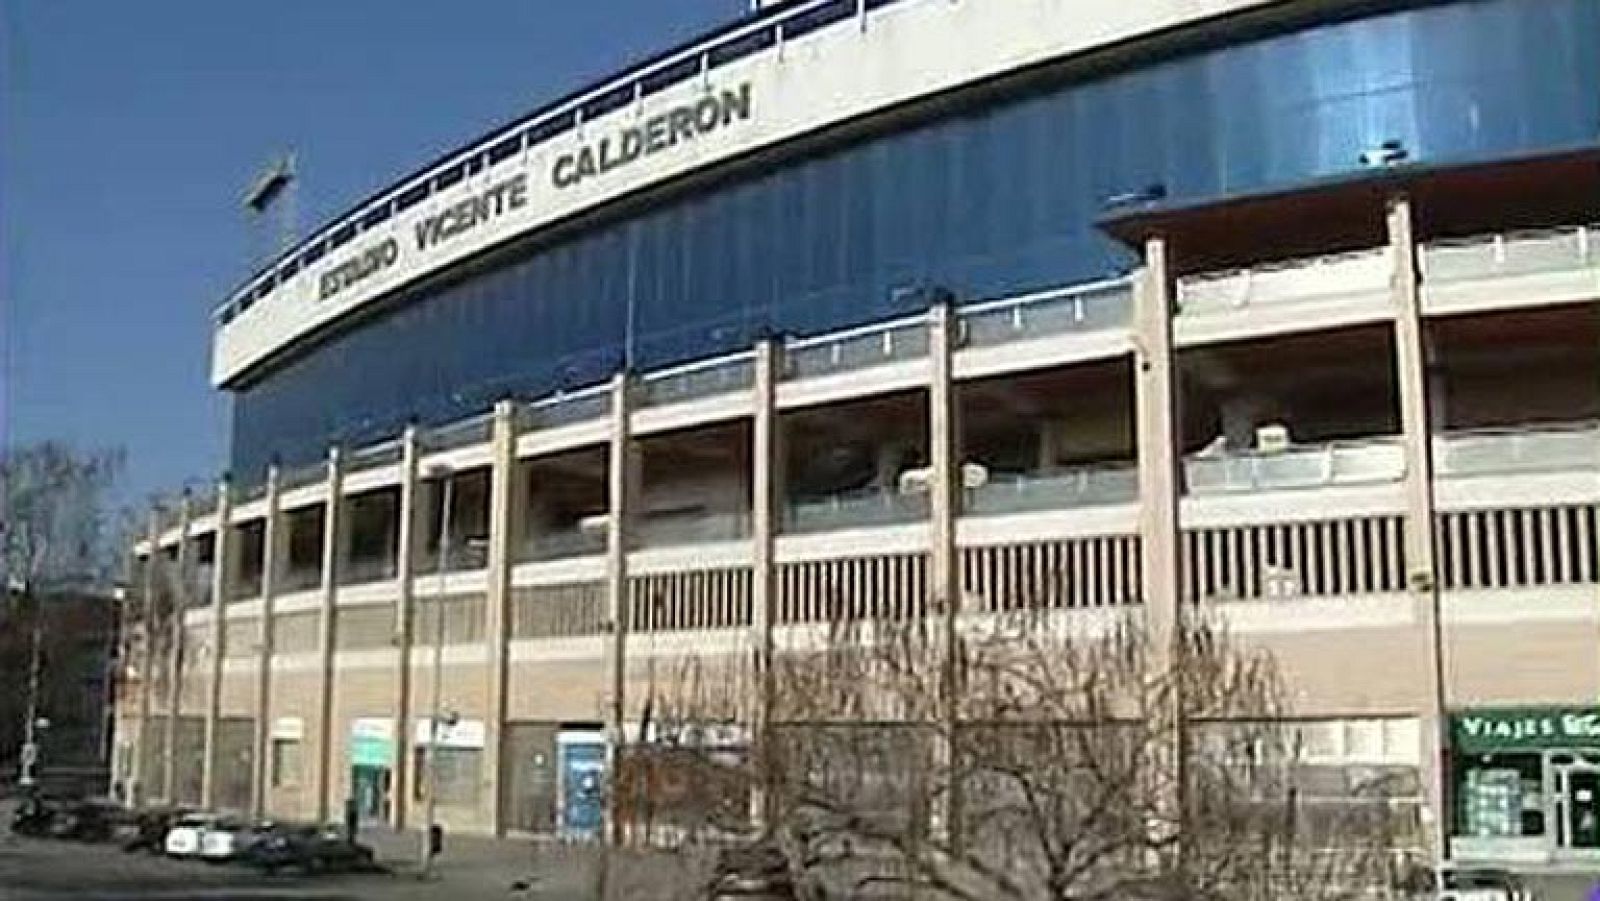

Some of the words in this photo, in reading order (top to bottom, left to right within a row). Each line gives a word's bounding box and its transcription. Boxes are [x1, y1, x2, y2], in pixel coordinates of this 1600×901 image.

[318, 237, 398, 301] ESTADIO
[414, 173, 528, 251] VICENTE
[552, 81, 752, 189] CALDERÓN
